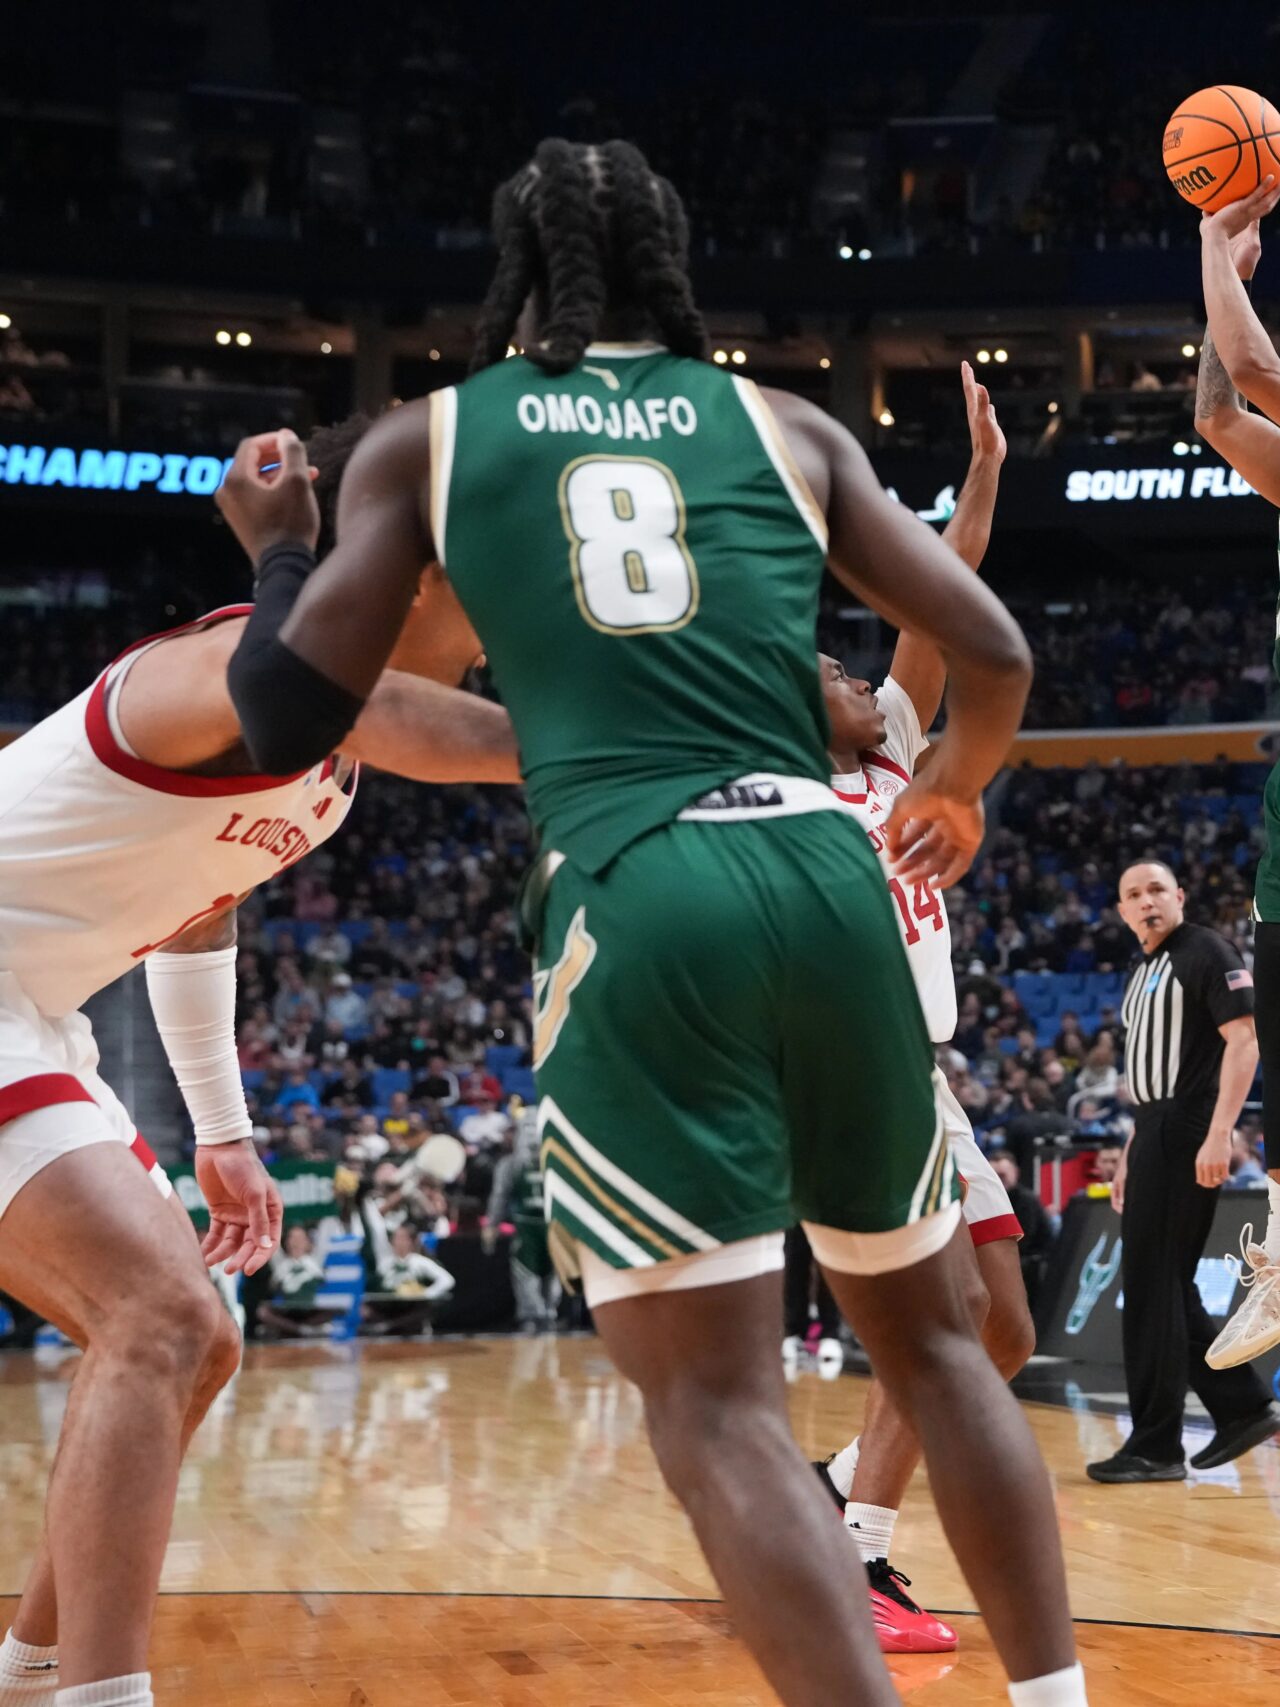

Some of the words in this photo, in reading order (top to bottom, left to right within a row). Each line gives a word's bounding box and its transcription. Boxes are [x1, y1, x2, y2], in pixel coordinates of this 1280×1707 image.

[517, 393, 697, 441] OMOJAFO
[0, 444, 234, 495] HAMPIO
[1066, 467, 1185, 501] SOUTH
[557, 453, 700, 636] 8
[215, 812, 312, 864] LOUISV
[888, 876, 944, 946] 14
